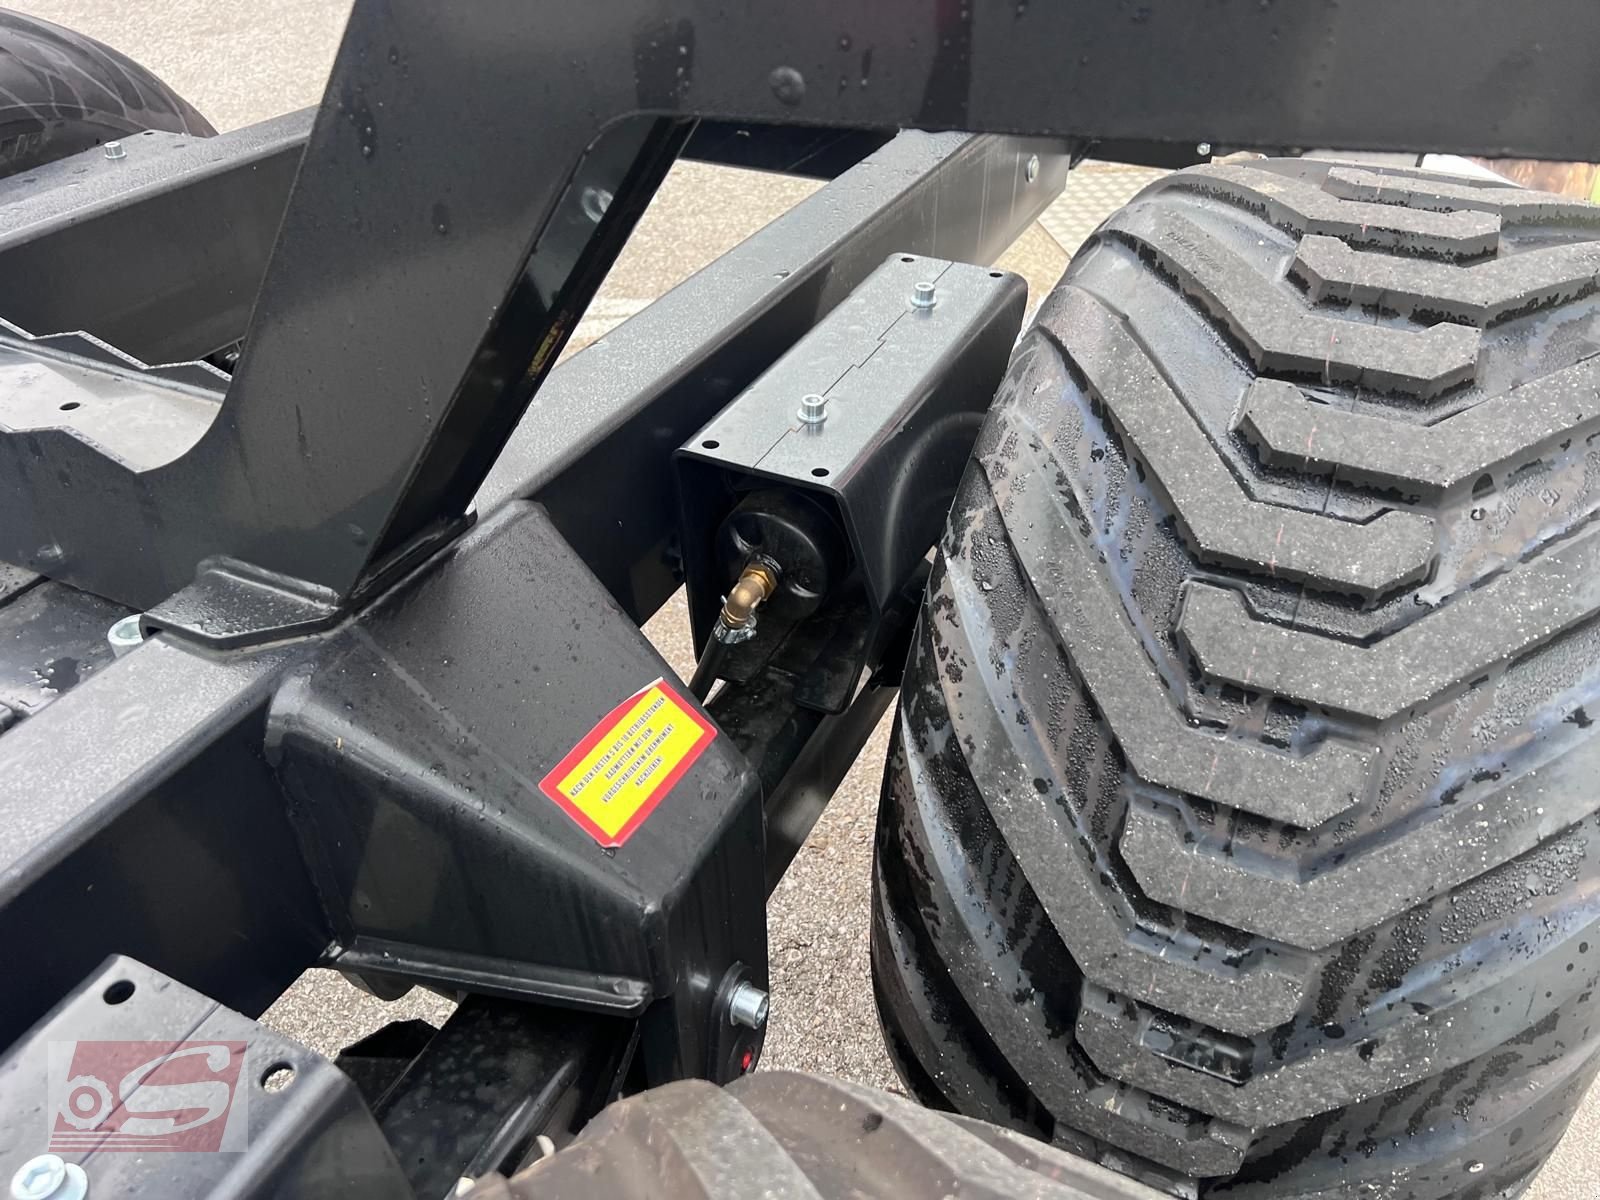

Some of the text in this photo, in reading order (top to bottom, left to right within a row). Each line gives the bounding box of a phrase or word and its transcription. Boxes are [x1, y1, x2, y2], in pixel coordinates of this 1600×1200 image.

[612, 740, 624, 751] BIS
[633, 737, 644, 748] MIT
[641, 727, 653, 739] DEM
